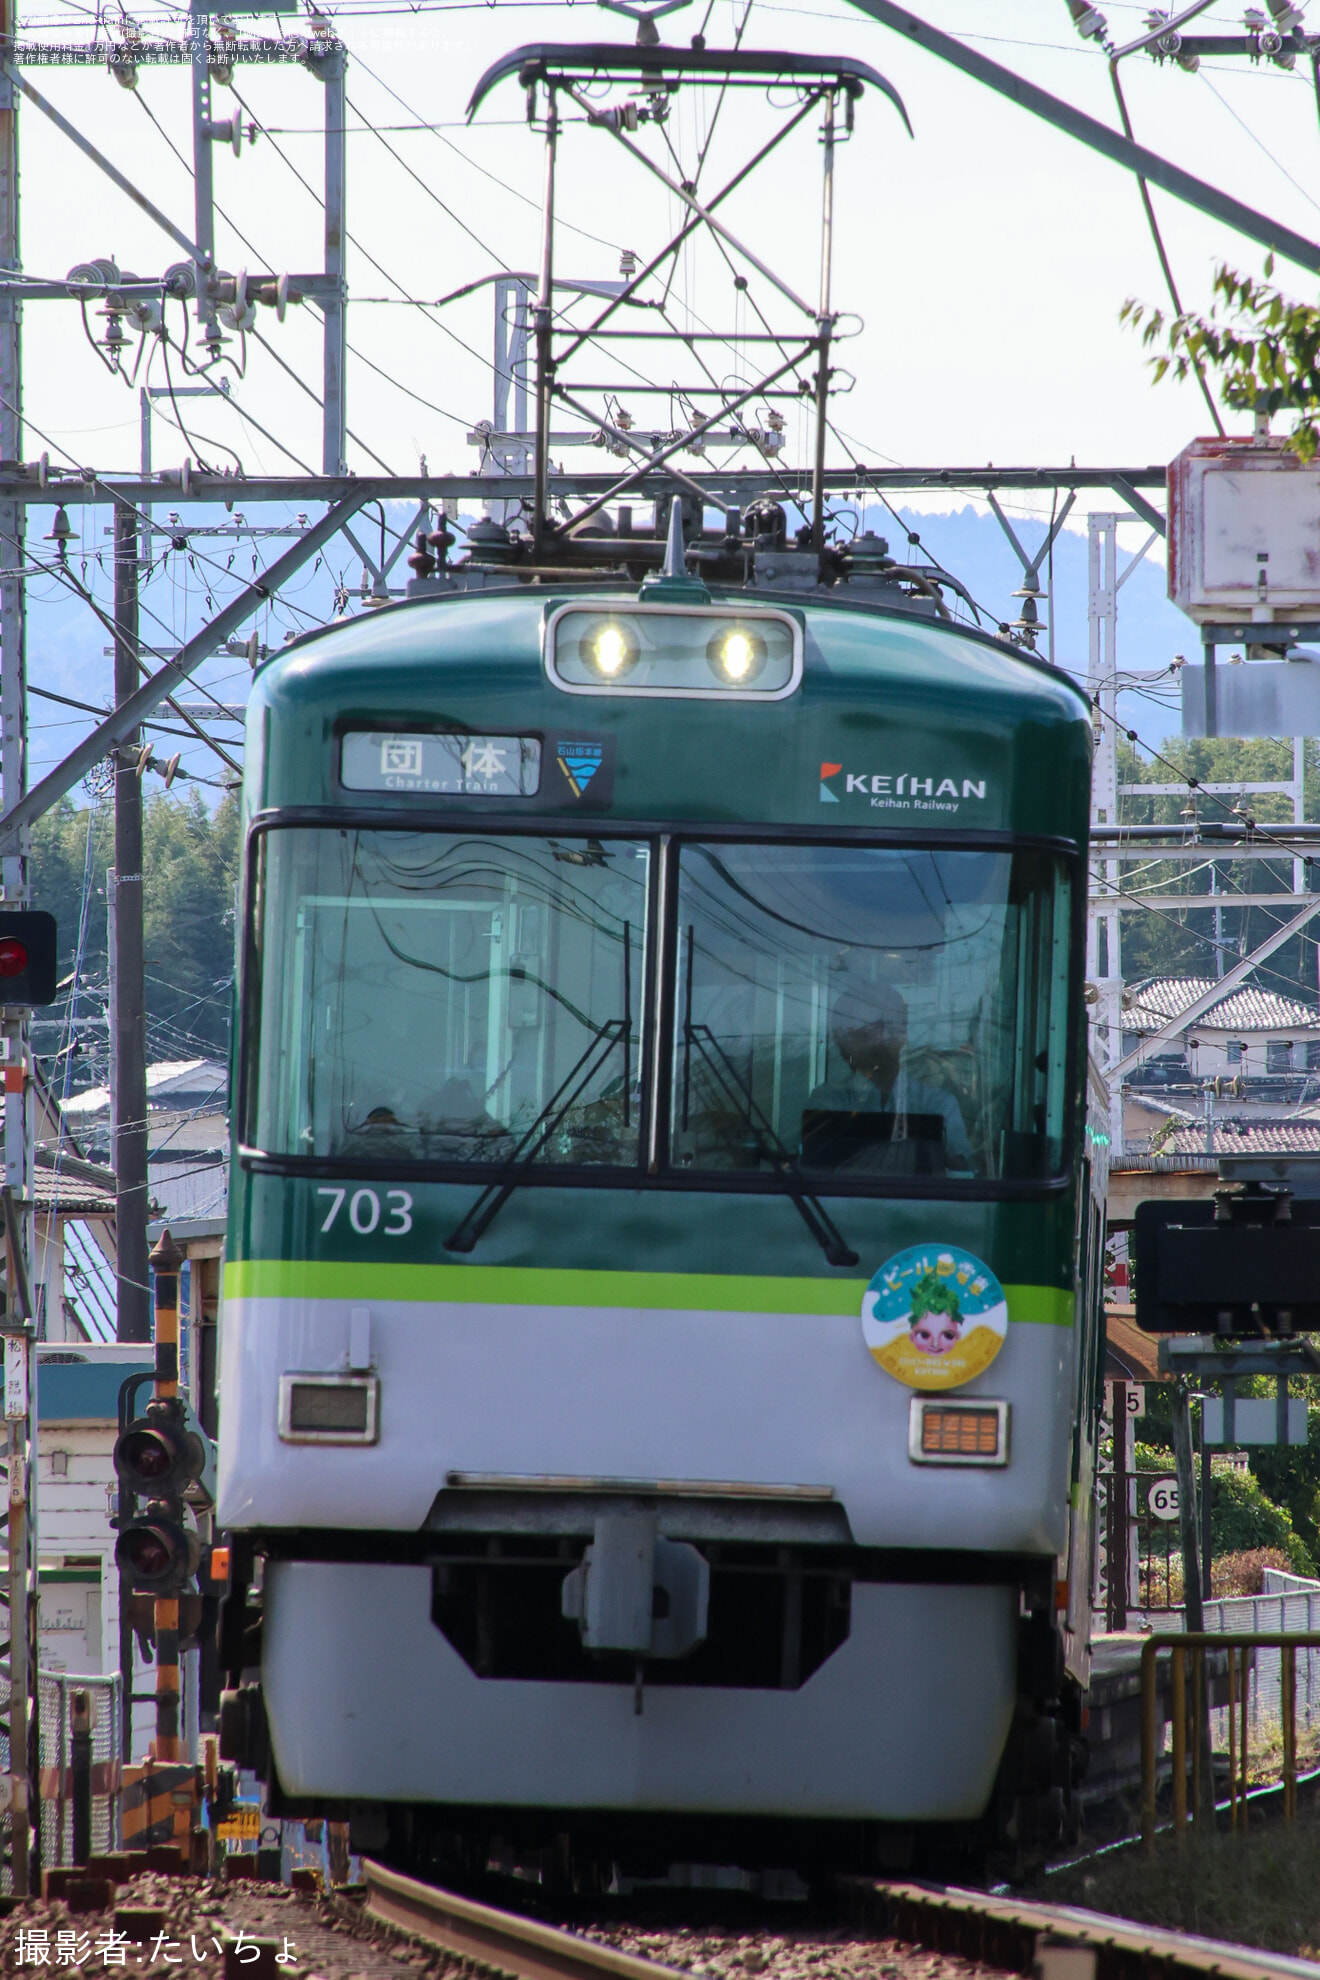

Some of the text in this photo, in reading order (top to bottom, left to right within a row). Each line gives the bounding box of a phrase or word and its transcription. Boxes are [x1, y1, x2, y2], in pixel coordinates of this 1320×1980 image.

[385, 776, 499, 792] Charter Train
[870, 797, 959, 813] Keihan Railway
[317, 1187, 413, 1235] 703
[1154, 1489, 1180, 1510] 65
